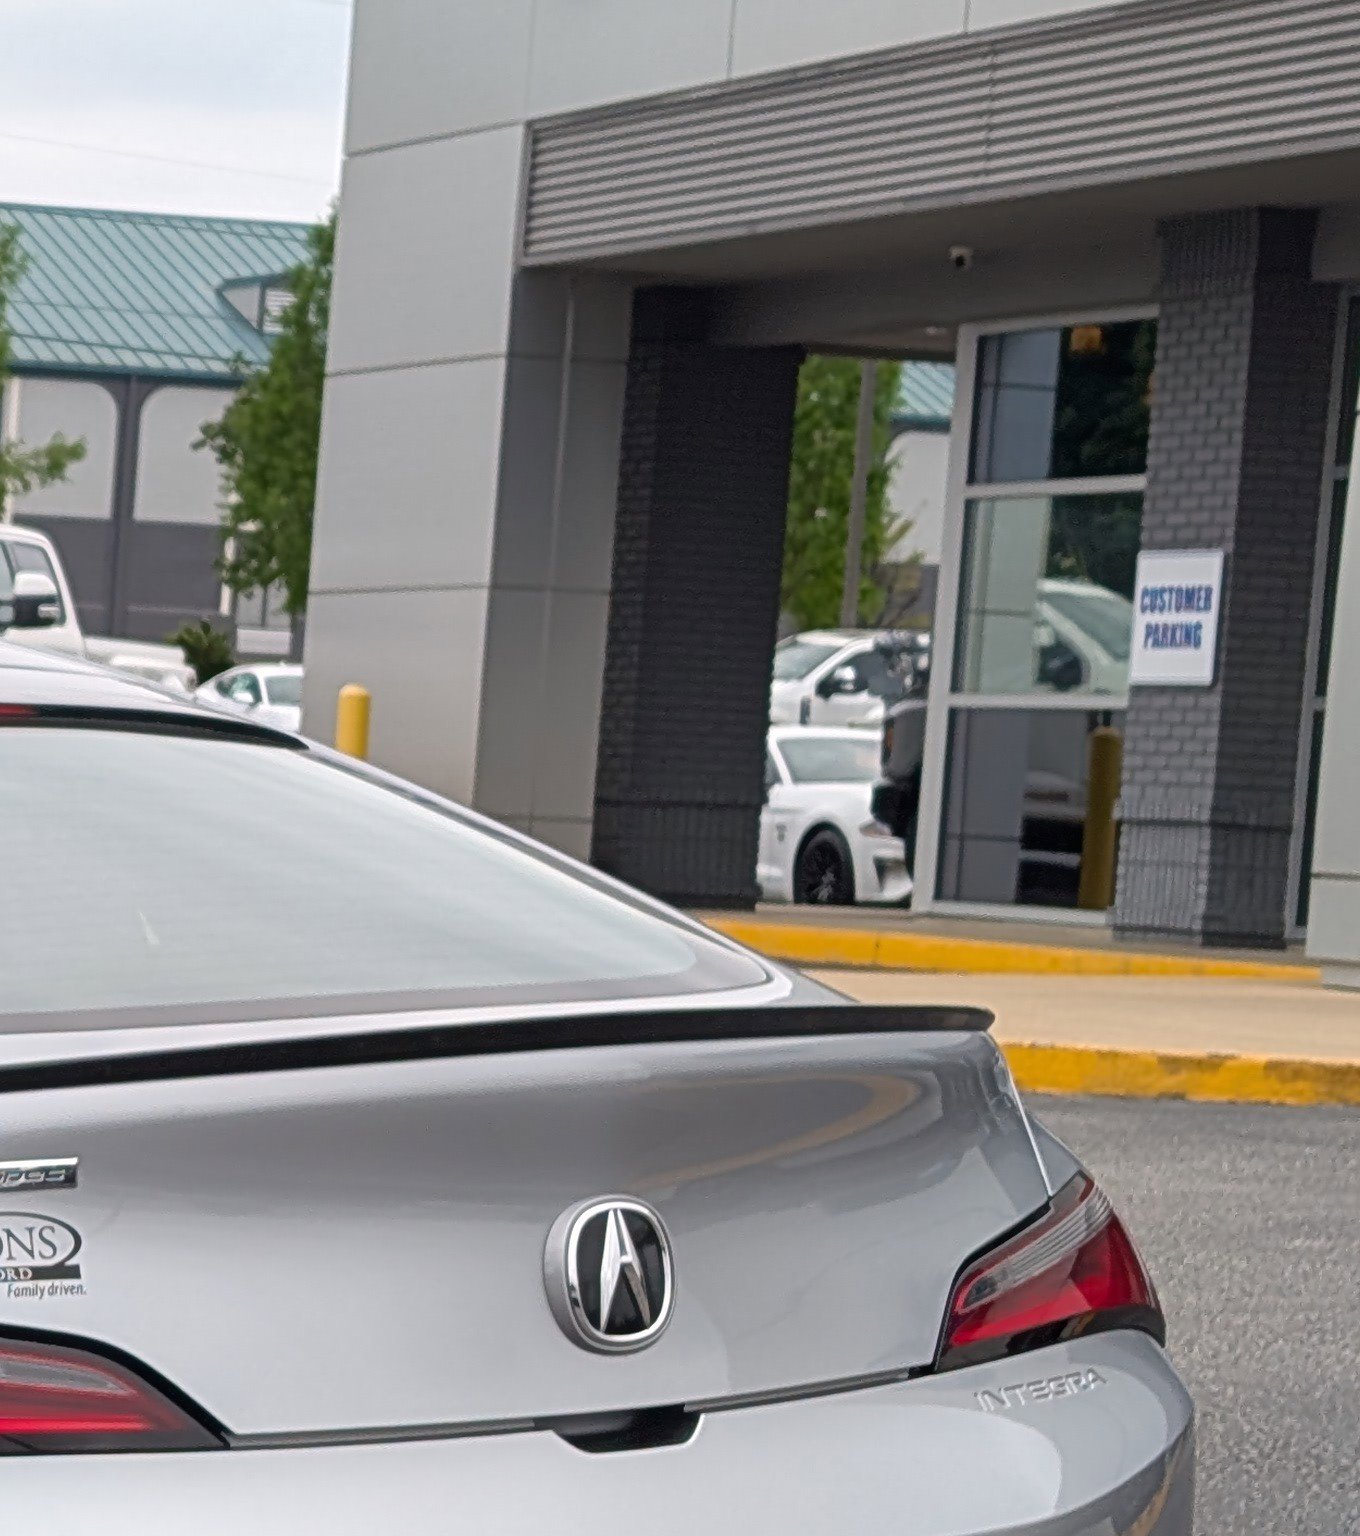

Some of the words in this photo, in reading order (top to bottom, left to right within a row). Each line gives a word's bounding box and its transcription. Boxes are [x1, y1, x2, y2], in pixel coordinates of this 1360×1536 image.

[1141, 585, 1213, 613] CUSTOMER
[1144, 622, 1203, 649] PARKING
[7, 1285, 45, 1300] Family
